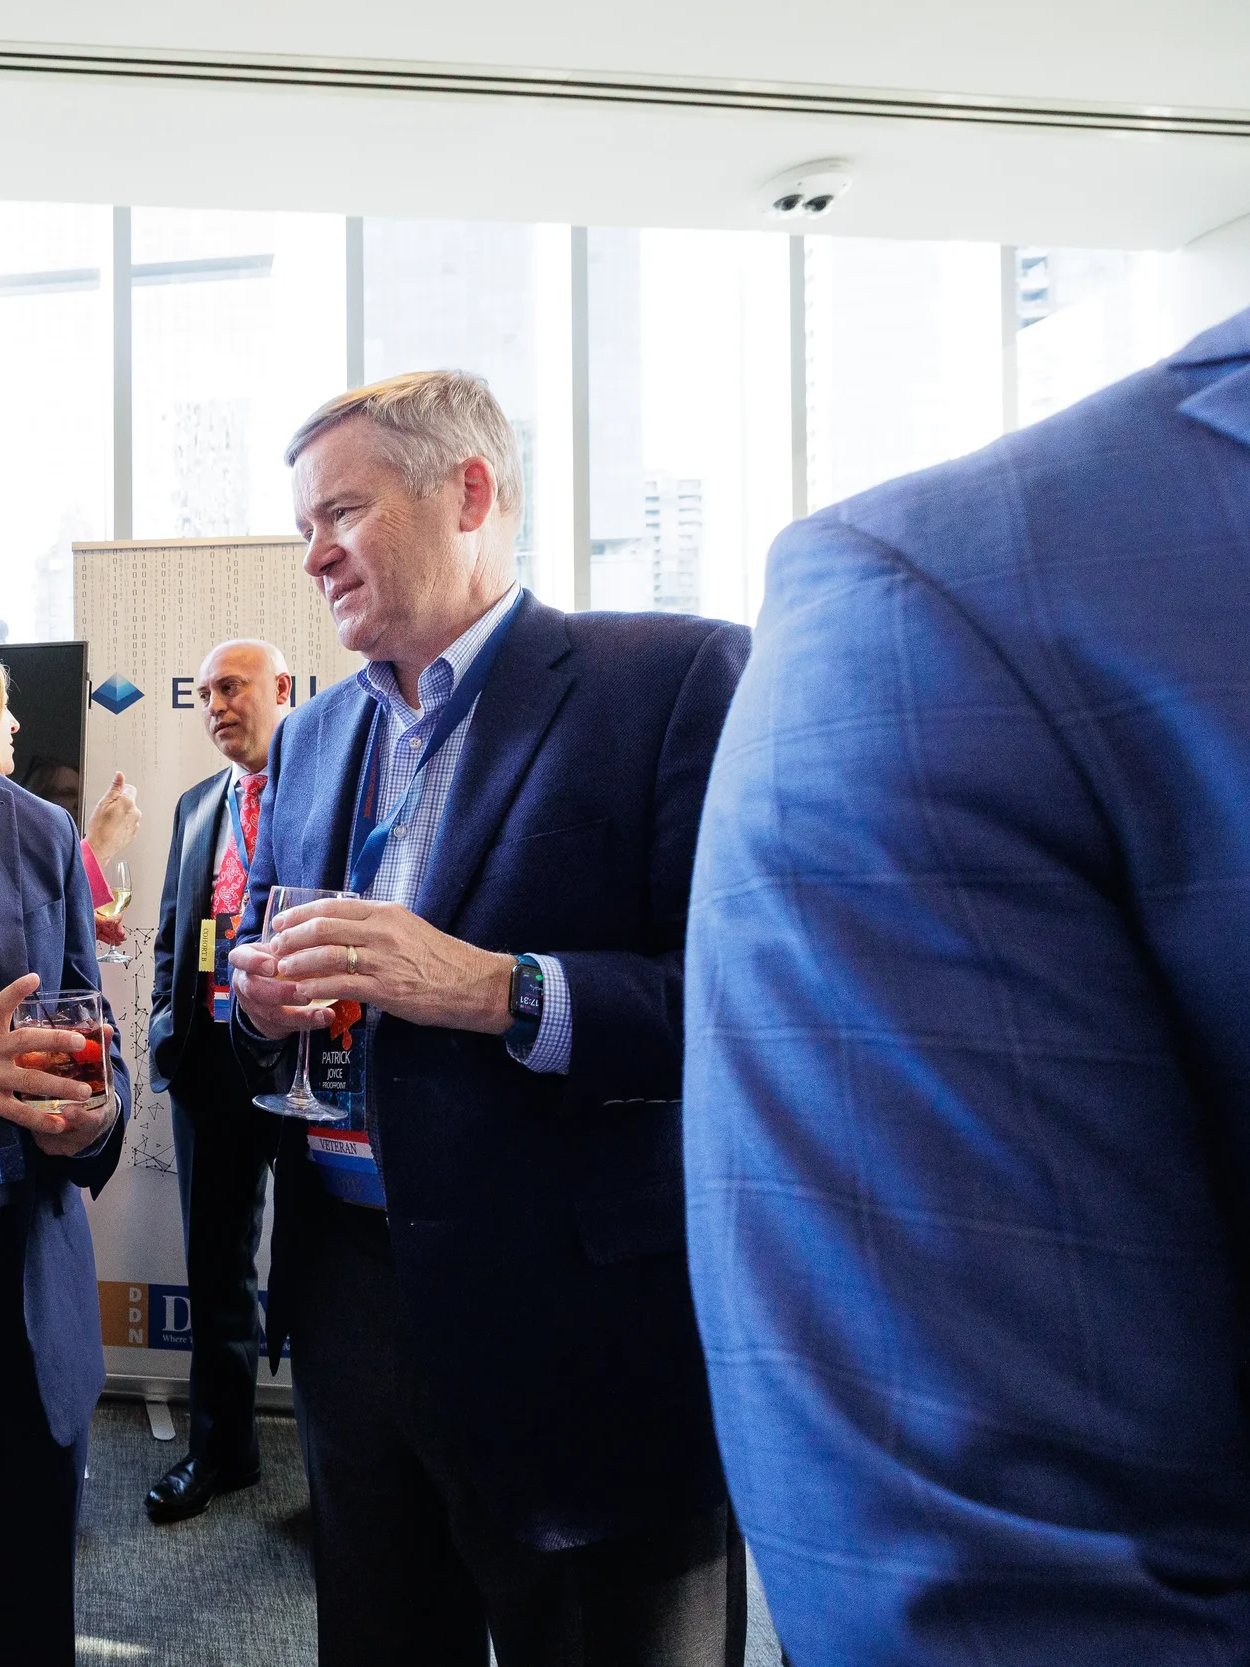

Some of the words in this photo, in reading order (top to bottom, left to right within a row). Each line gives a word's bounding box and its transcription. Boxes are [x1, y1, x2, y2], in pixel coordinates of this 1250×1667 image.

[201, 928, 209, 953] COHORT
[520, 996, 539, 1007] 17:31
[321, 1050, 351, 1064] PATRICK
[326, 1068, 343, 1080] JOYCE
[322, 1081, 347, 1089] PROOFPOINT
[319, 1138, 358, 1155] VETERAN
[162, 1333, 188, 1344] Where
